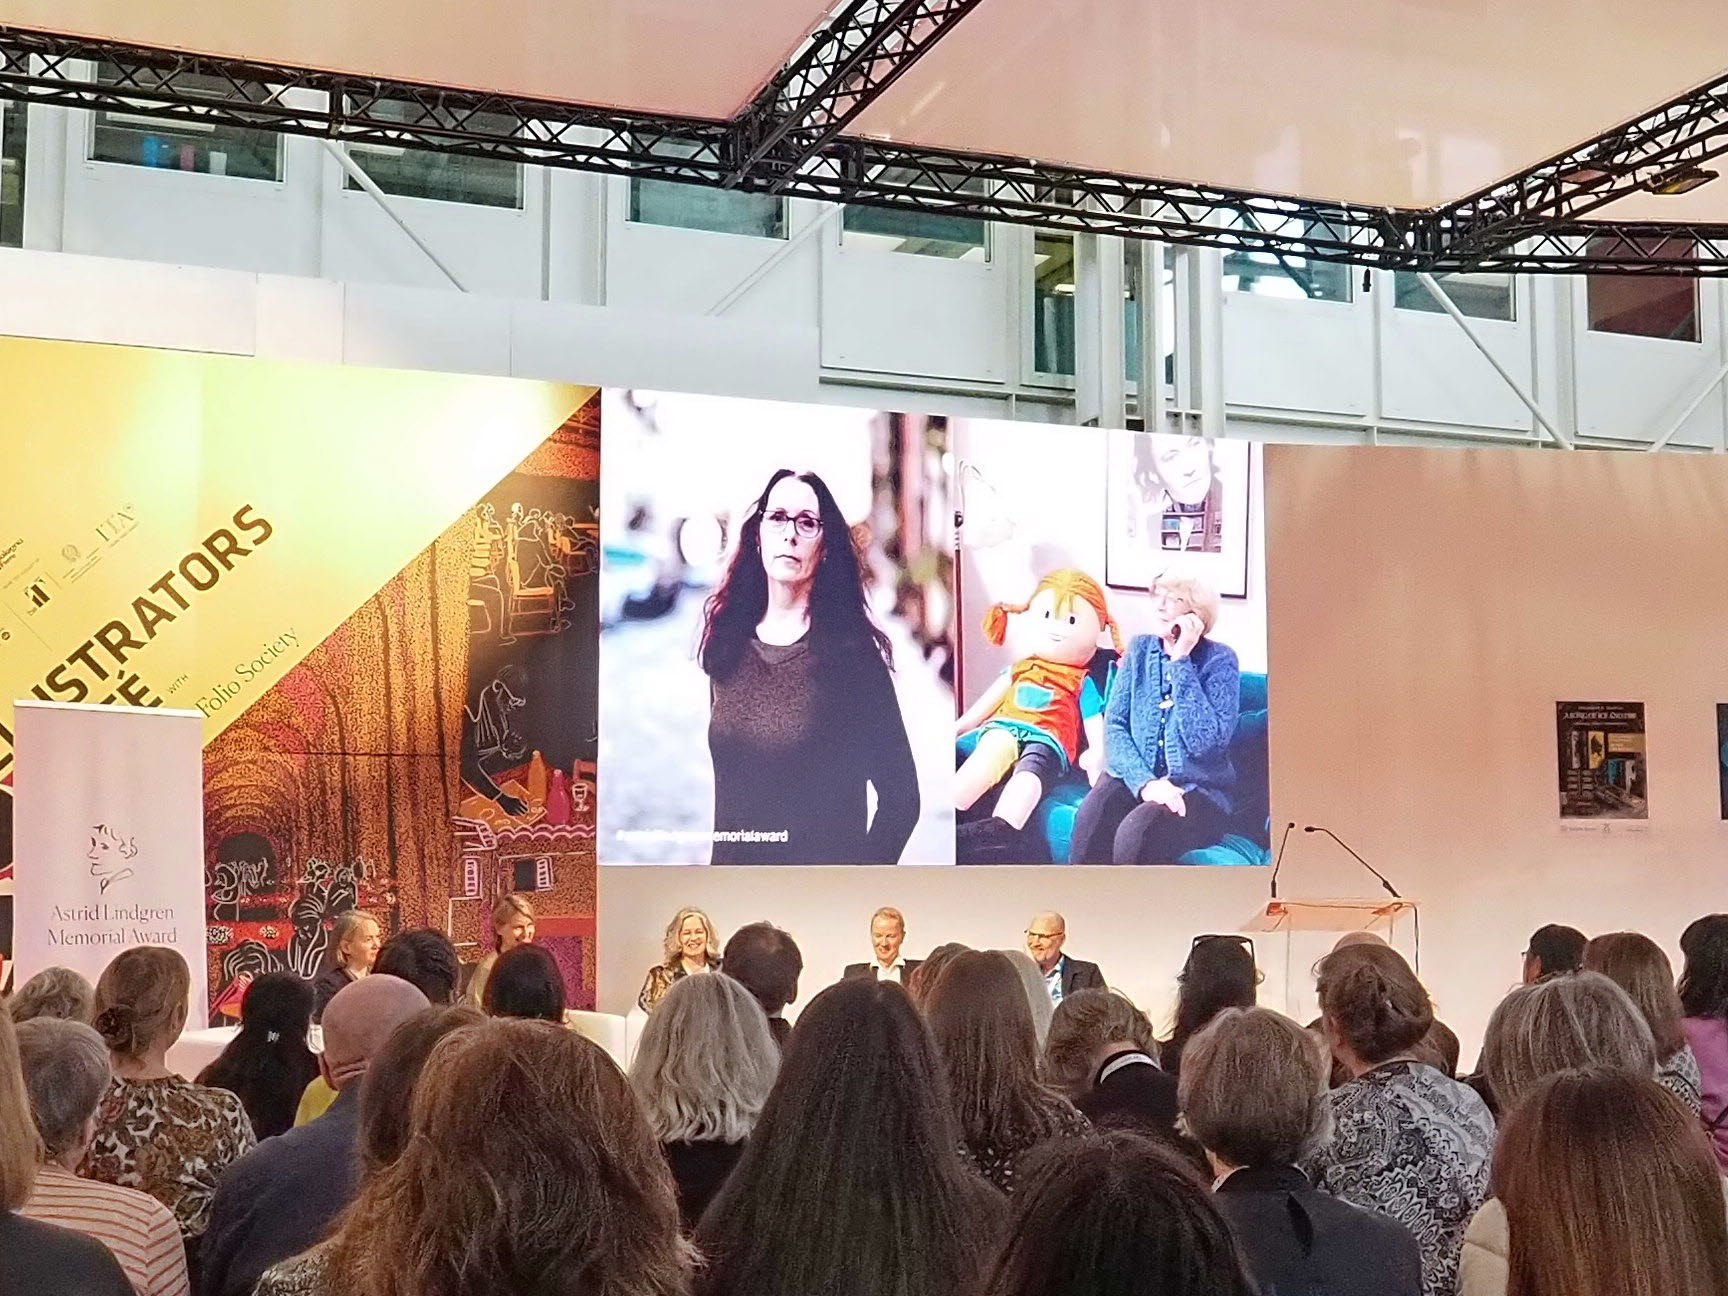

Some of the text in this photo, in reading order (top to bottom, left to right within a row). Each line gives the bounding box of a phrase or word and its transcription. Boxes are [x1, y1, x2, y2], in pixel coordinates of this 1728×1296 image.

[194, 681, 242, 718] Folio
[234, 627, 300, 683] Society
[52, 905, 175, 924] Astrid Lindgren
[47, 927, 178, 947] Memorial Award
